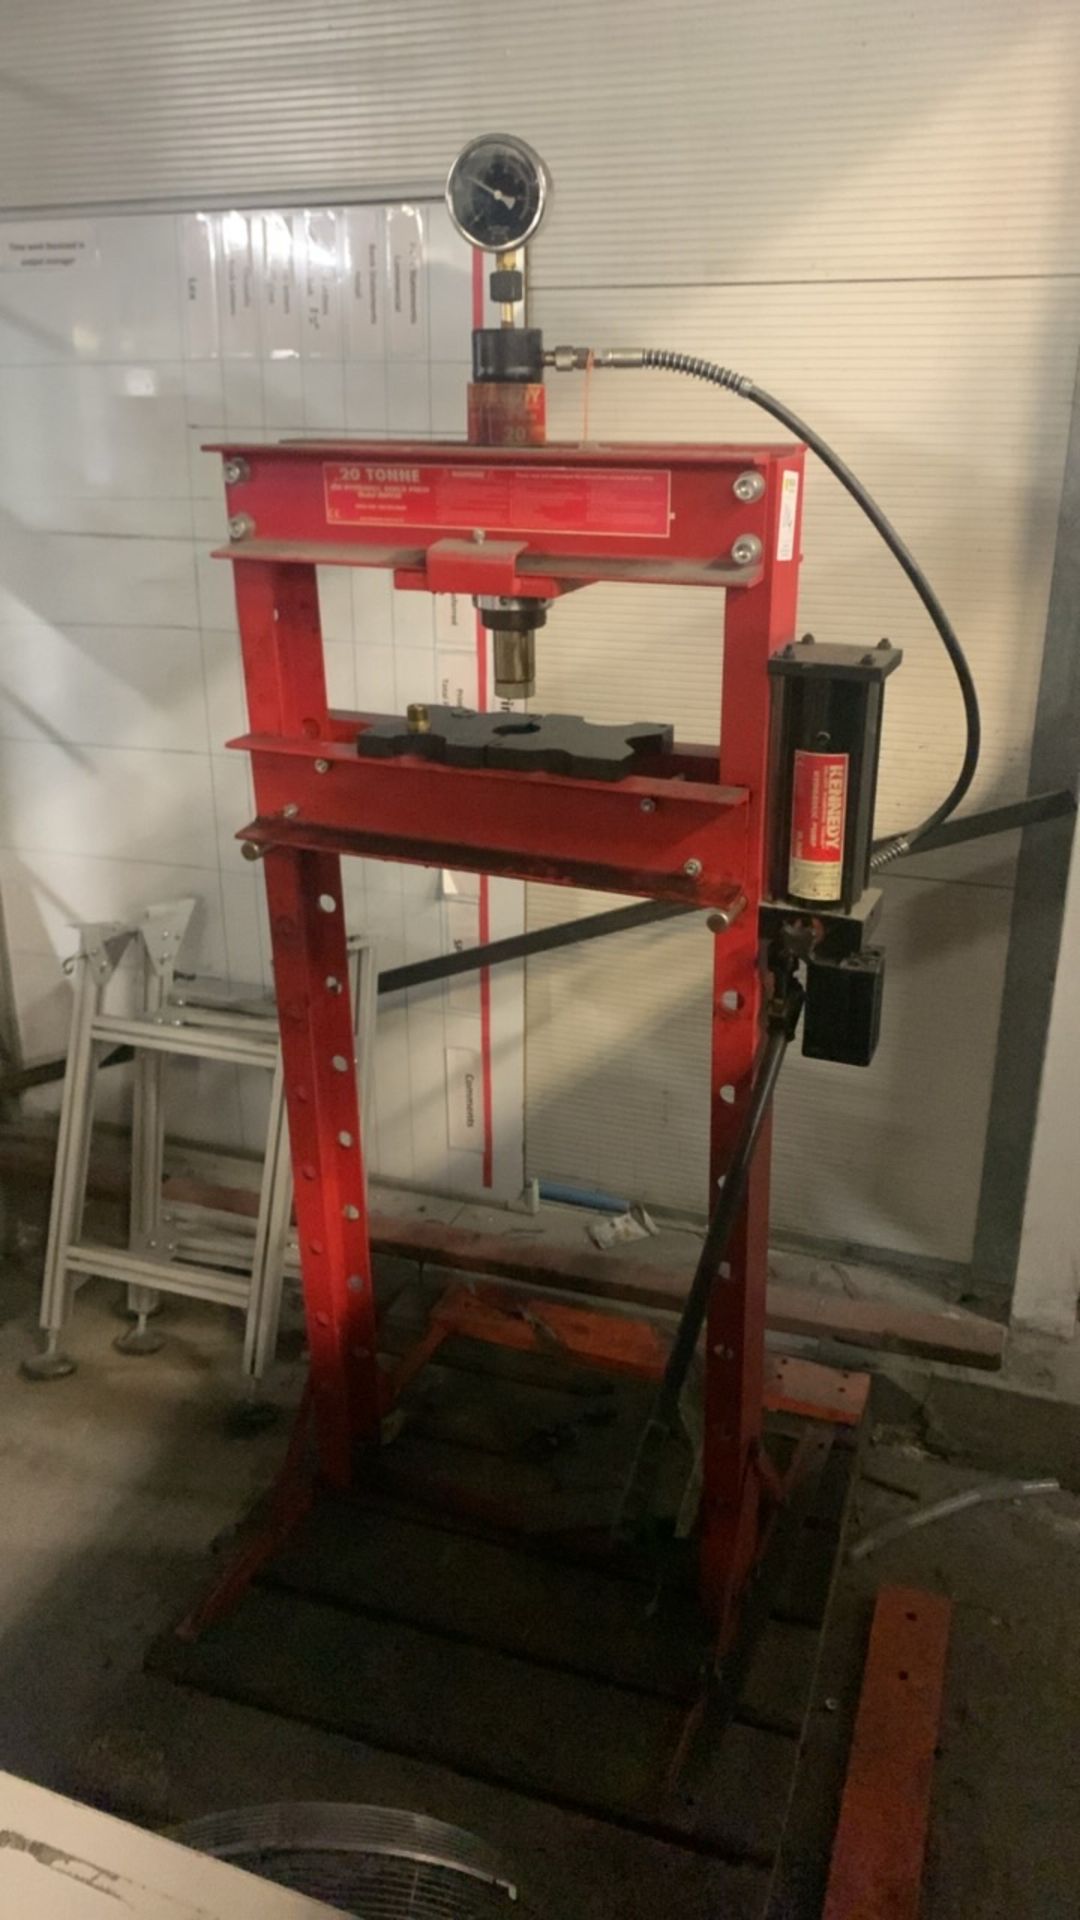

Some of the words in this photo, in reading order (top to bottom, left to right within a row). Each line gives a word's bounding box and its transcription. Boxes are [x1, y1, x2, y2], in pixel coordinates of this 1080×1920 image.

[339, 467, 361, 481] 20
[365, 468, 421, 483] TONNE
[826, 765, 844, 849] KENNEDY
[464, 1073, 475, 1128] Comments
